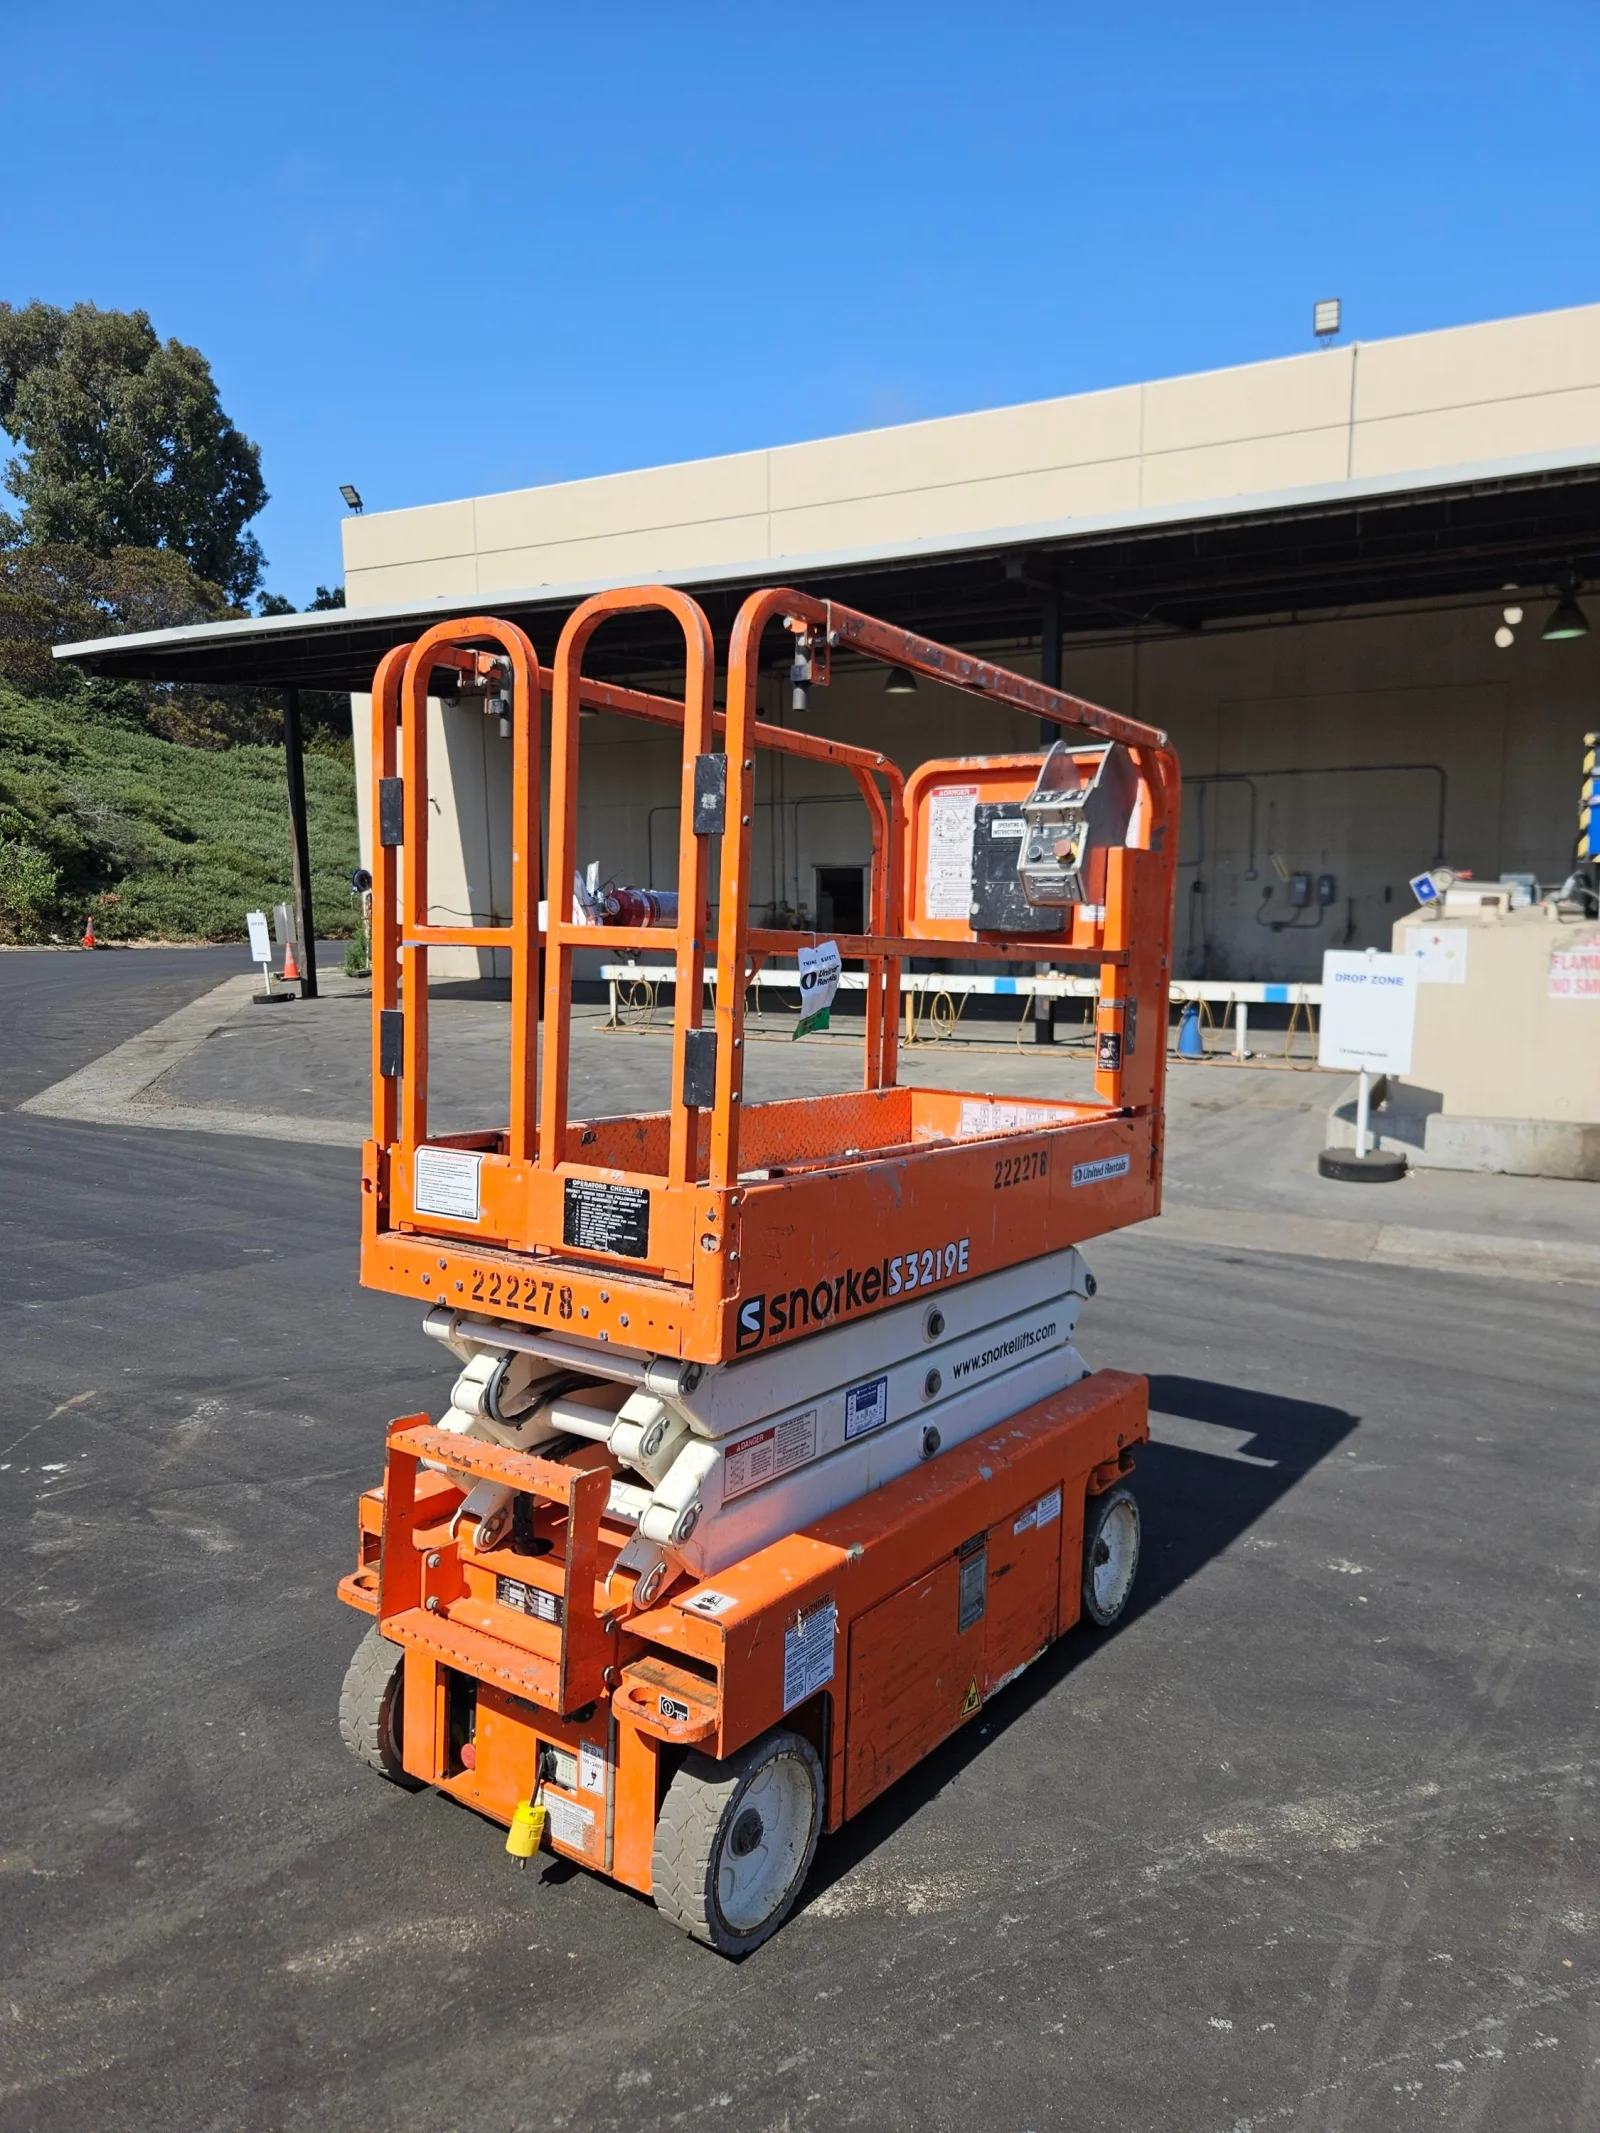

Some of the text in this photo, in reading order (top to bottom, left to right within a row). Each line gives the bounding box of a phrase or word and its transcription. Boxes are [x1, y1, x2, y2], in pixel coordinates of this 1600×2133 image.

[943, 789, 970, 797] DANGER
[1335, 973, 1404, 987] DROP ZONE
[994, 1151, 1047, 1189] 222278
[1082, 1159, 1127, 1180] United Rentals
[572, 1179, 644, 1196] OPERATORS CHECKLIST
[471, 1269, 573, 1320] 222278
[768, 1258, 888, 1337] snorkel
[888, 1237, 970, 1297] S3219E
[953, 1322, 1056, 1379] www.snorkellifts.com
[740, 1433, 764, 1450] DANGER
